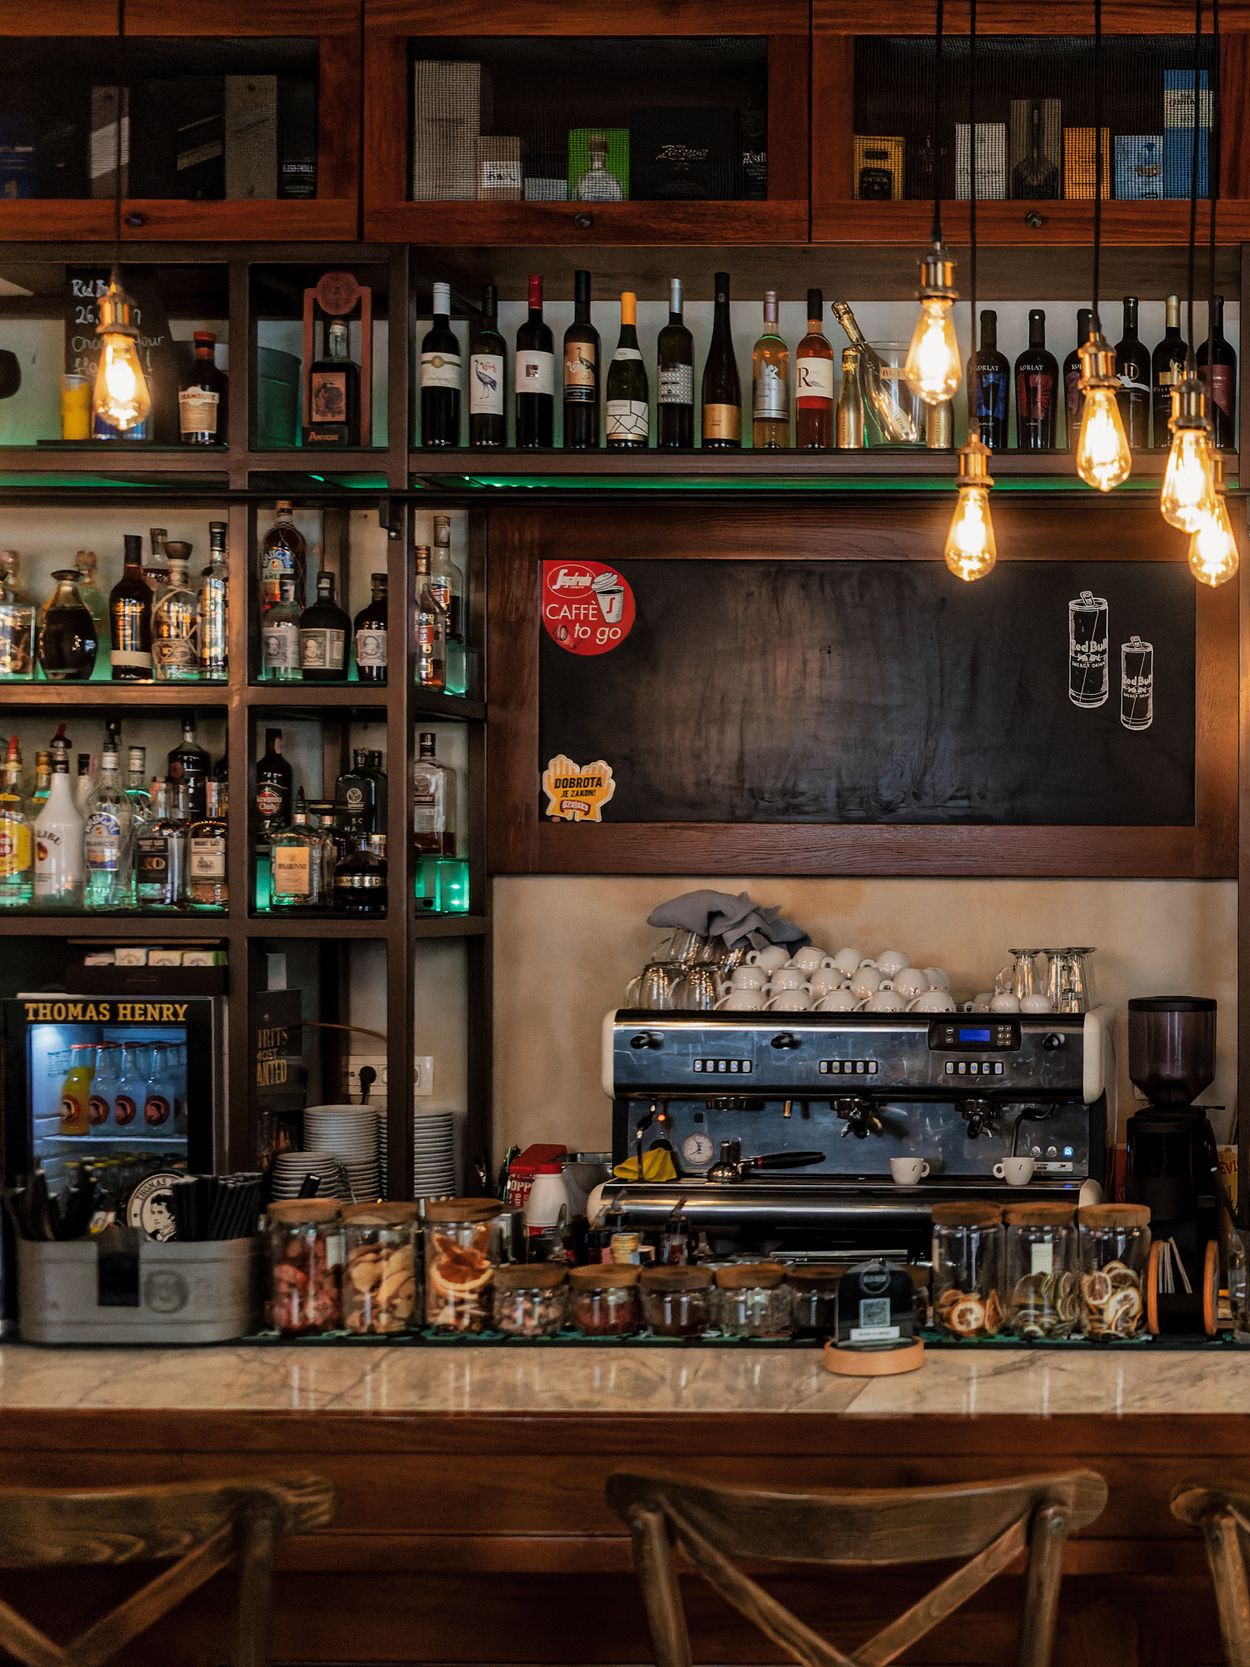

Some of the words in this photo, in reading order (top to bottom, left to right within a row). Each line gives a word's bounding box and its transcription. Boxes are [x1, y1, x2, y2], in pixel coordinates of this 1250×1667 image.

[546, 600, 598, 621] CAFFÈ
[574, 623, 591, 639] to
[595, 627, 621, 645] go
[1071, 640, 1089, 652] Red
[554, 777, 603, 789] DOBROTA
[24, 1003, 111, 1021] THOMAS
[117, 1004, 189, 1021] HENRY
[257, 1059, 288, 1087] ANTED
